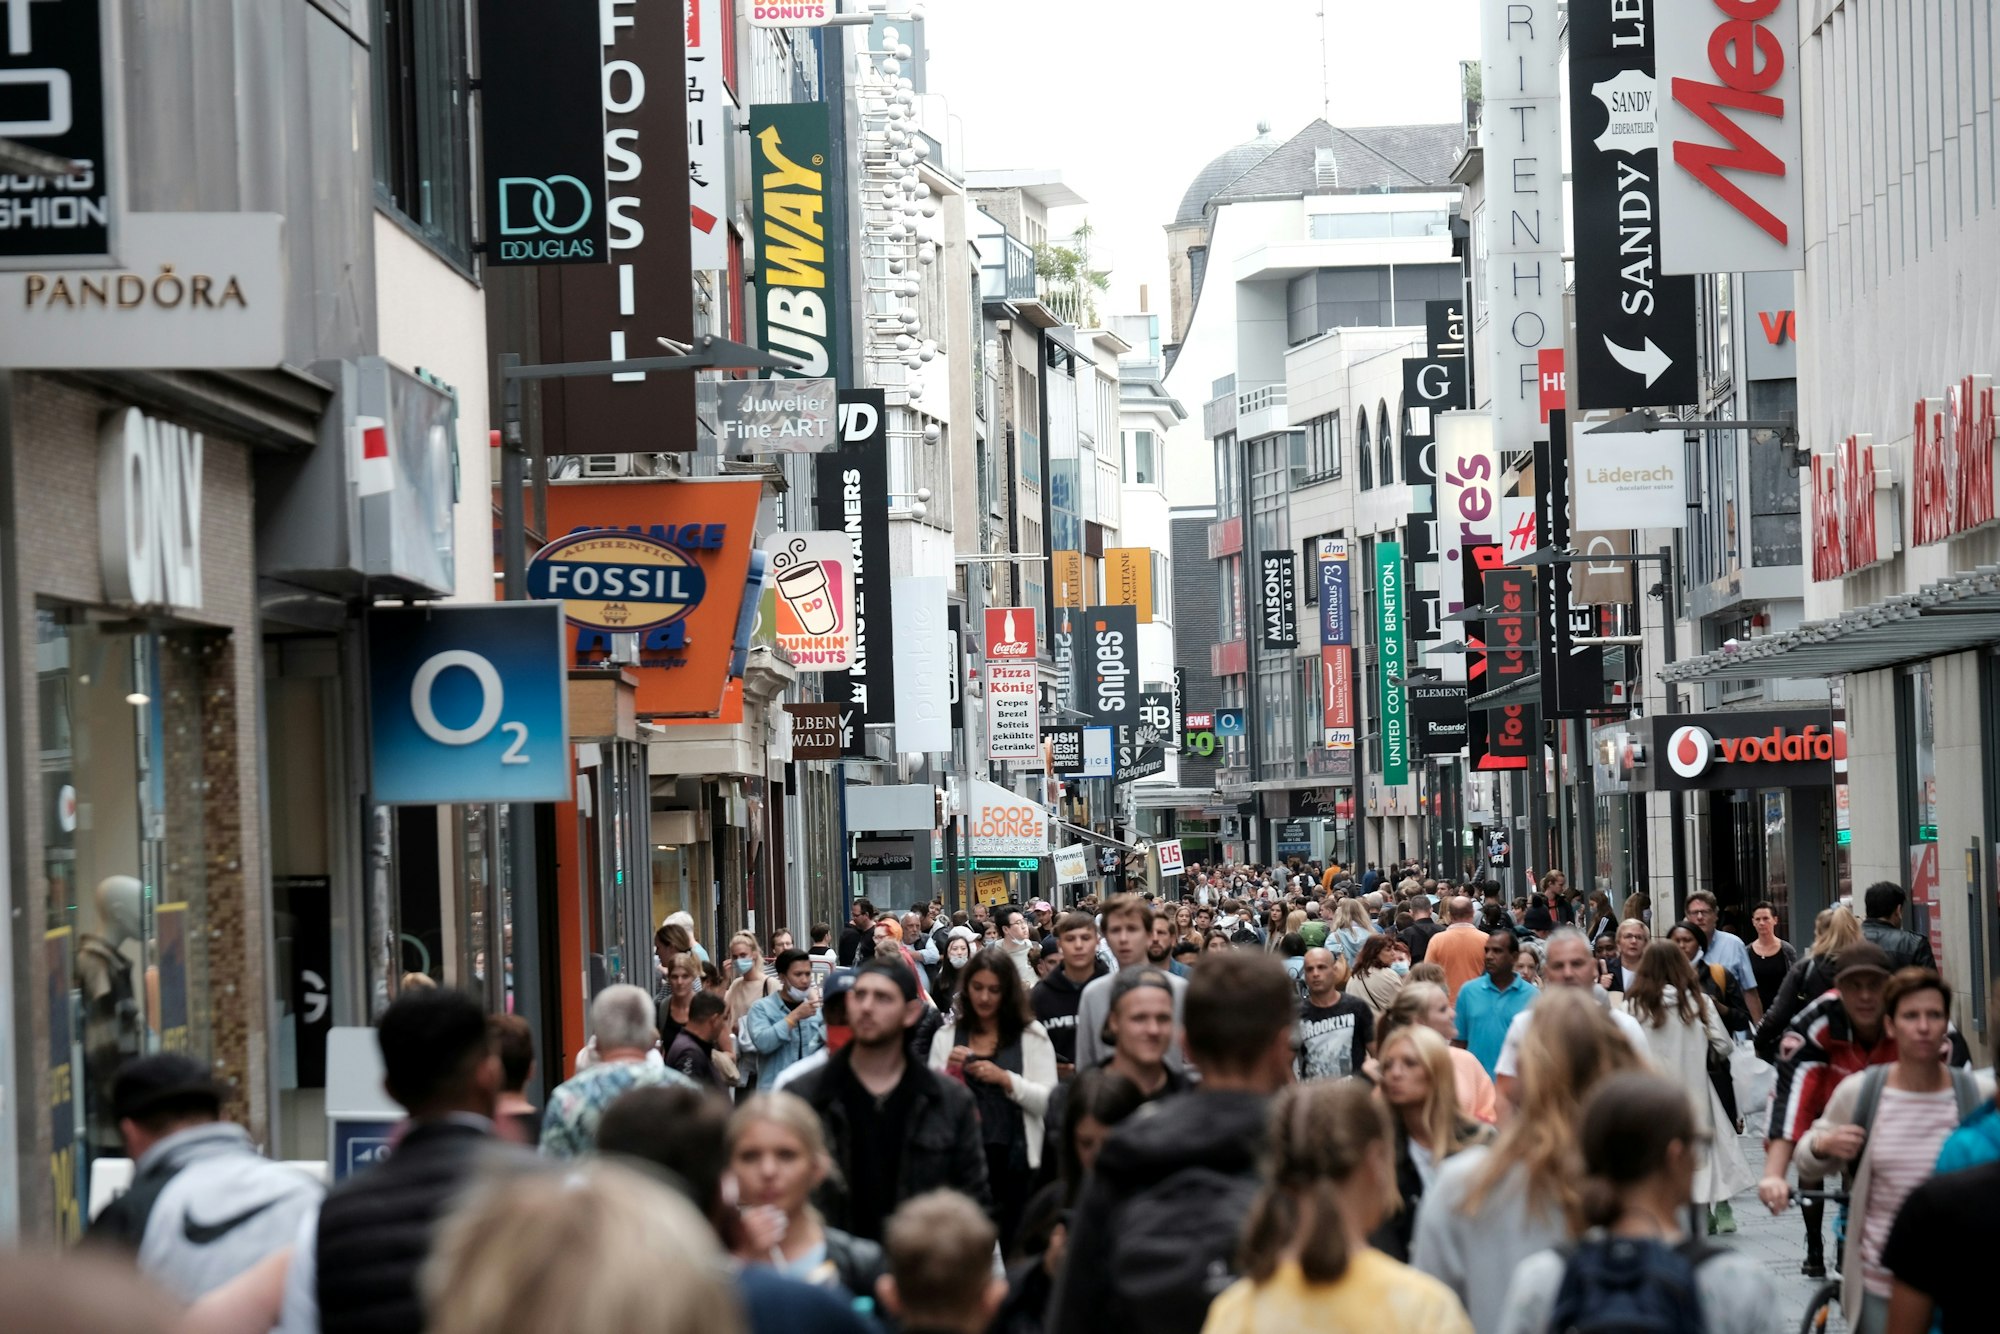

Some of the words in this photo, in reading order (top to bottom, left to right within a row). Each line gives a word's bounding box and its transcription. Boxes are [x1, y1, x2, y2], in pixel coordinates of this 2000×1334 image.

[754, 6, 824, 19] DONUTS
[1612, 91, 1651, 112] SANDY
[1617, 161, 1654, 316] SANDY
[500, 239, 594, 260] DOUGLAS
[757, 124, 829, 381] UBWAY
[742, 396, 828, 413] Juwelier
[723, 420, 774, 439] Fine
[780, 418, 828, 438] ART
[1586, 465, 1673, 484] Läderach
[562, 540, 674, 563] AUTHENTIC
[1324, 541, 1344, 554] dm
[547, 565, 690, 599] FOSSIL
[1324, 564, 1342, 585] 73
[1283, 557, 1293, 612] MONDE
[1264, 558, 1282, 641] MAISONS
[1286, 623, 1294, 641] DU
[1497, 580, 1524, 674] Locker
[1386, 637, 1398, 655] OF
[902, 606, 942, 724] pimkie
[992, 667, 1031, 679] Pizza
[1097, 630, 1131, 712] snipes
[990, 681, 1034, 695] König
[996, 699, 1029, 707] Crepes
[996, 720, 1029, 729] Softeis
[1498, 704, 1523, 746] Foo
[792, 735, 835, 748] WALD
[992, 732, 1034, 741] gekühlte
[1330, 730, 1350, 742] dm
[1388, 719, 1401, 767] UNITED
[1116, 759, 1162, 781] Belgique
[982, 806, 1034, 822] FOOD
[973, 822, 1042, 837] LOUNGE
[1054, 850, 1083, 863] Pommes
[1160, 844, 1180, 864] EIS
[977, 878, 1003, 888] Coffee
[991, 886, 1002, 896] go
[1300, 1012, 1355, 1039] BROOKLYN
